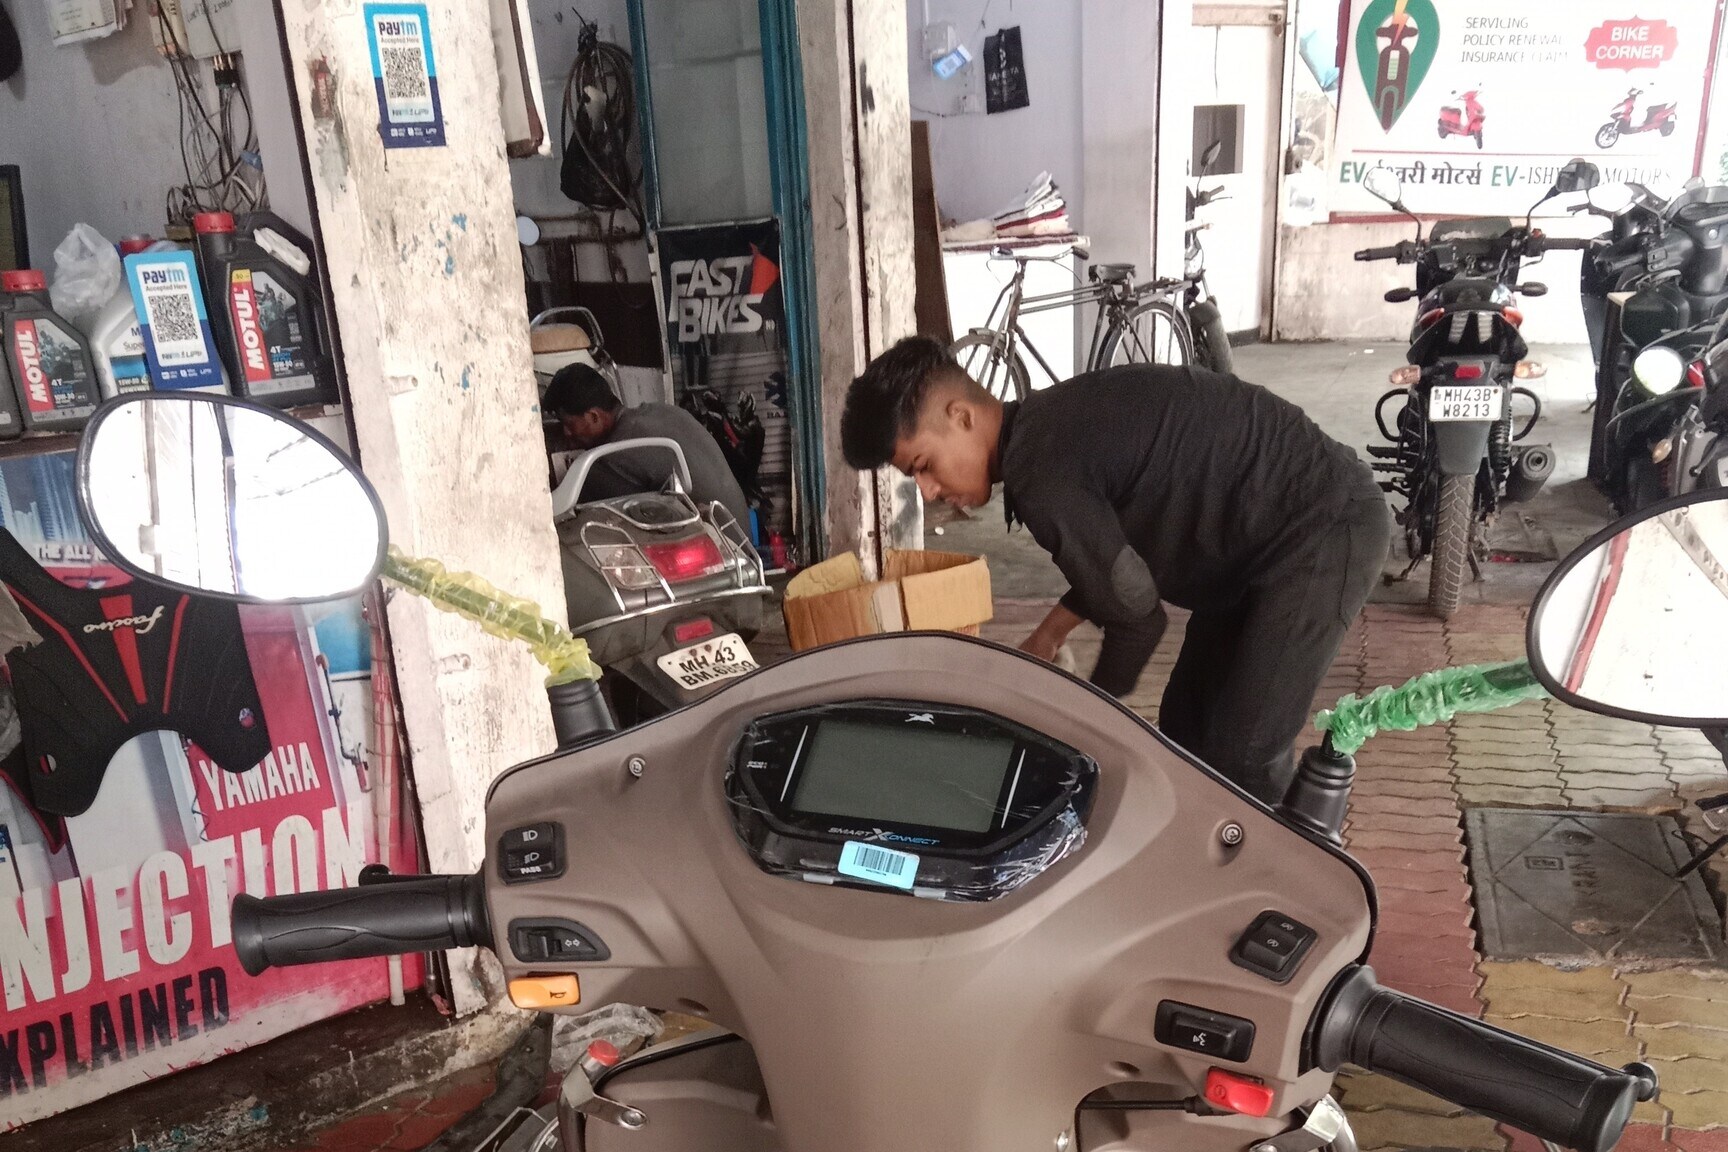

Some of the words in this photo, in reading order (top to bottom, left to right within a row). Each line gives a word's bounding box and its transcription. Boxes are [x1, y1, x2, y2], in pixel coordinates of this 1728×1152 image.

[1465, 16, 1529, 29] SERVICING
[1463, 34, 1504, 46] POLICY
[1611, 26, 1649, 42] BIKE
[1595, 44, 1664, 61] CORNER
[1431, 161, 1482, 185] मोटर्स
[668, 254, 754, 323] FAST
[678, 292, 764, 343] BIKES
[233, 288, 266, 371] MOTUL
[16, 329, 49, 403] MOTUL
[1443, 388, 1492, 402] MH43B
[1442, 403, 1490, 418] W8213
[34, 544, 61, 561] THE
[63, 544, 92, 562] ALL
[199, 742, 320, 812] YAMAHA
